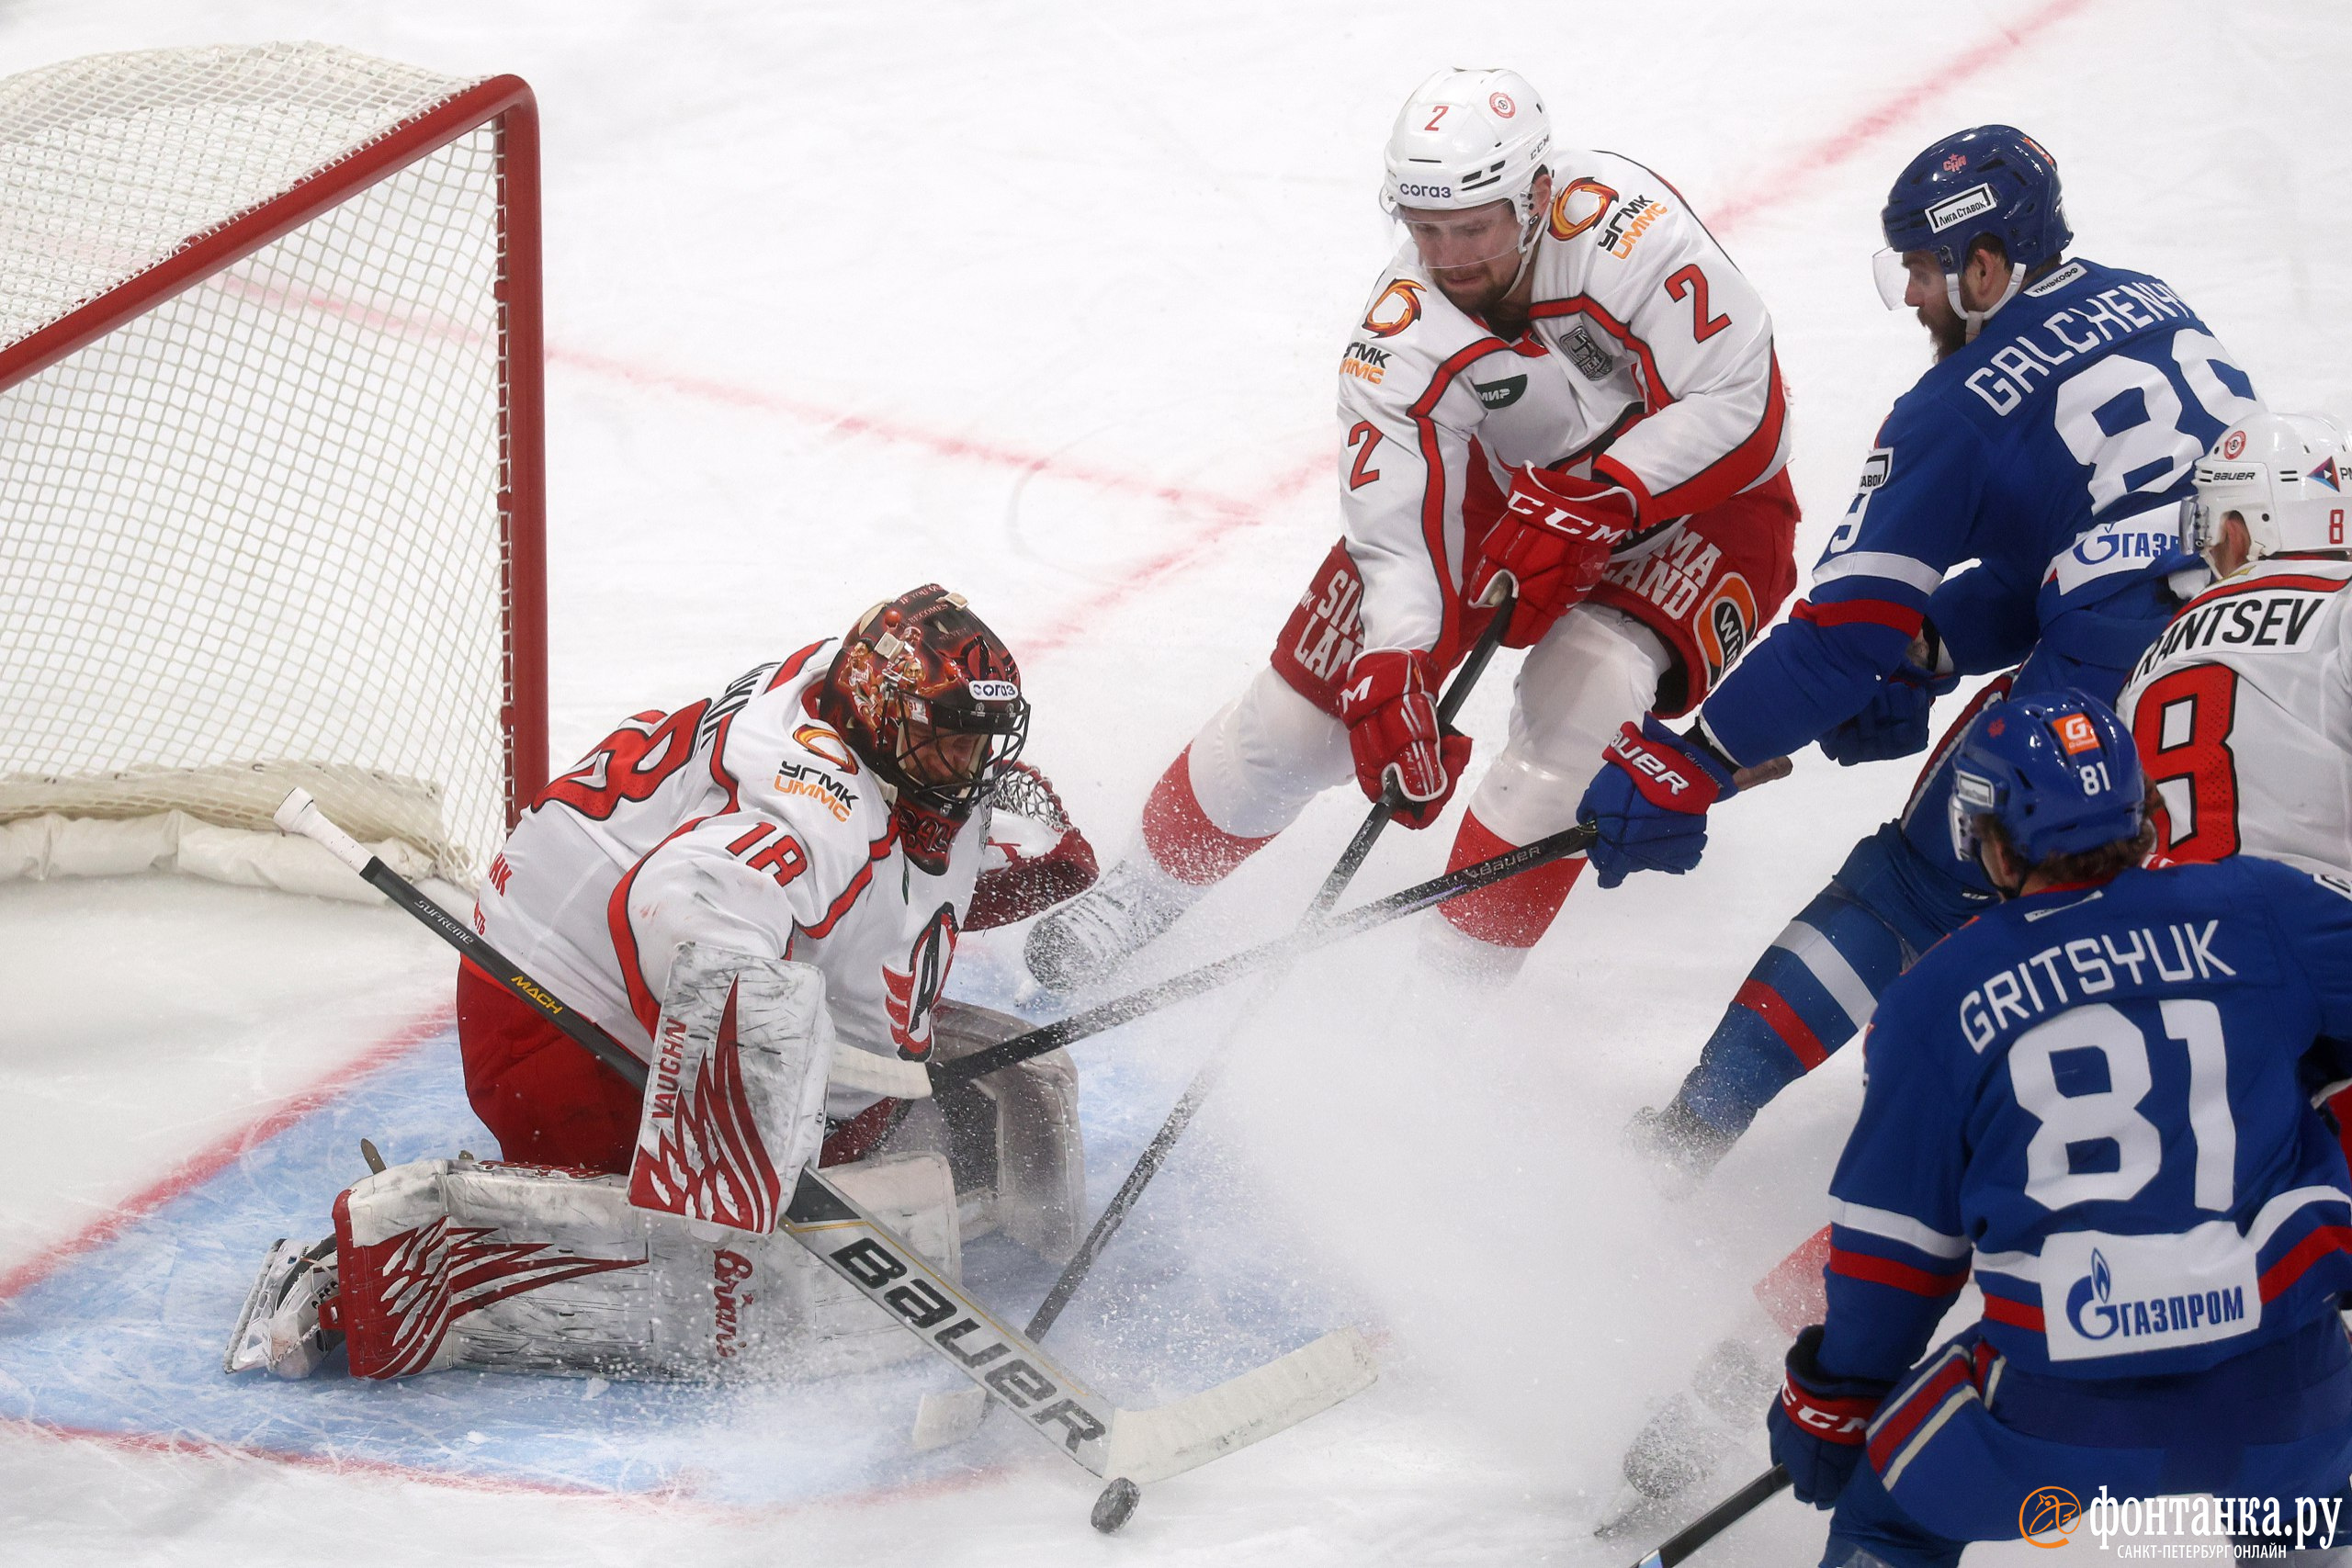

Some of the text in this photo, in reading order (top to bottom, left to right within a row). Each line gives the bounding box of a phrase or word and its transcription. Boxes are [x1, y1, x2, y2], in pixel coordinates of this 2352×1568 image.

[1424, 105, 1449, 131] 2
[1530, 134, 1550, 160] CCM
[1598, 194, 1655, 252] УГМК
[1611, 201, 1668, 260] UMMC
[1664, 264, 1732, 344] 2
[1340, 358, 1385, 385] MMC
[1348, 420, 1384, 491] 2
[1860, 474, 1883, 488] АВОК
[1508, 491, 1628, 546] CCM
[2329, 509, 2344, 545] 8
[2128, 598, 2324, 687] RANTSEV
[774, 774, 851, 823] UMMC
[779, 760, 859, 810] УГМК
[2079, 761, 2111, 796] 81
[725, 820, 808, 887] 18
[414, 899, 475, 945] SUPREME
[511, 976, 563, 1015] MACH
[1959, 919, 2237, 1055] GRITSYUK
[651, 1017, 687, 1119] VAUGHN
[2007, 999, 2236, 1213] 81
[2121, 1286, 2245, 1337] ГАЗПРОМ
[828, 1236, 1106, 1453] BAUER
